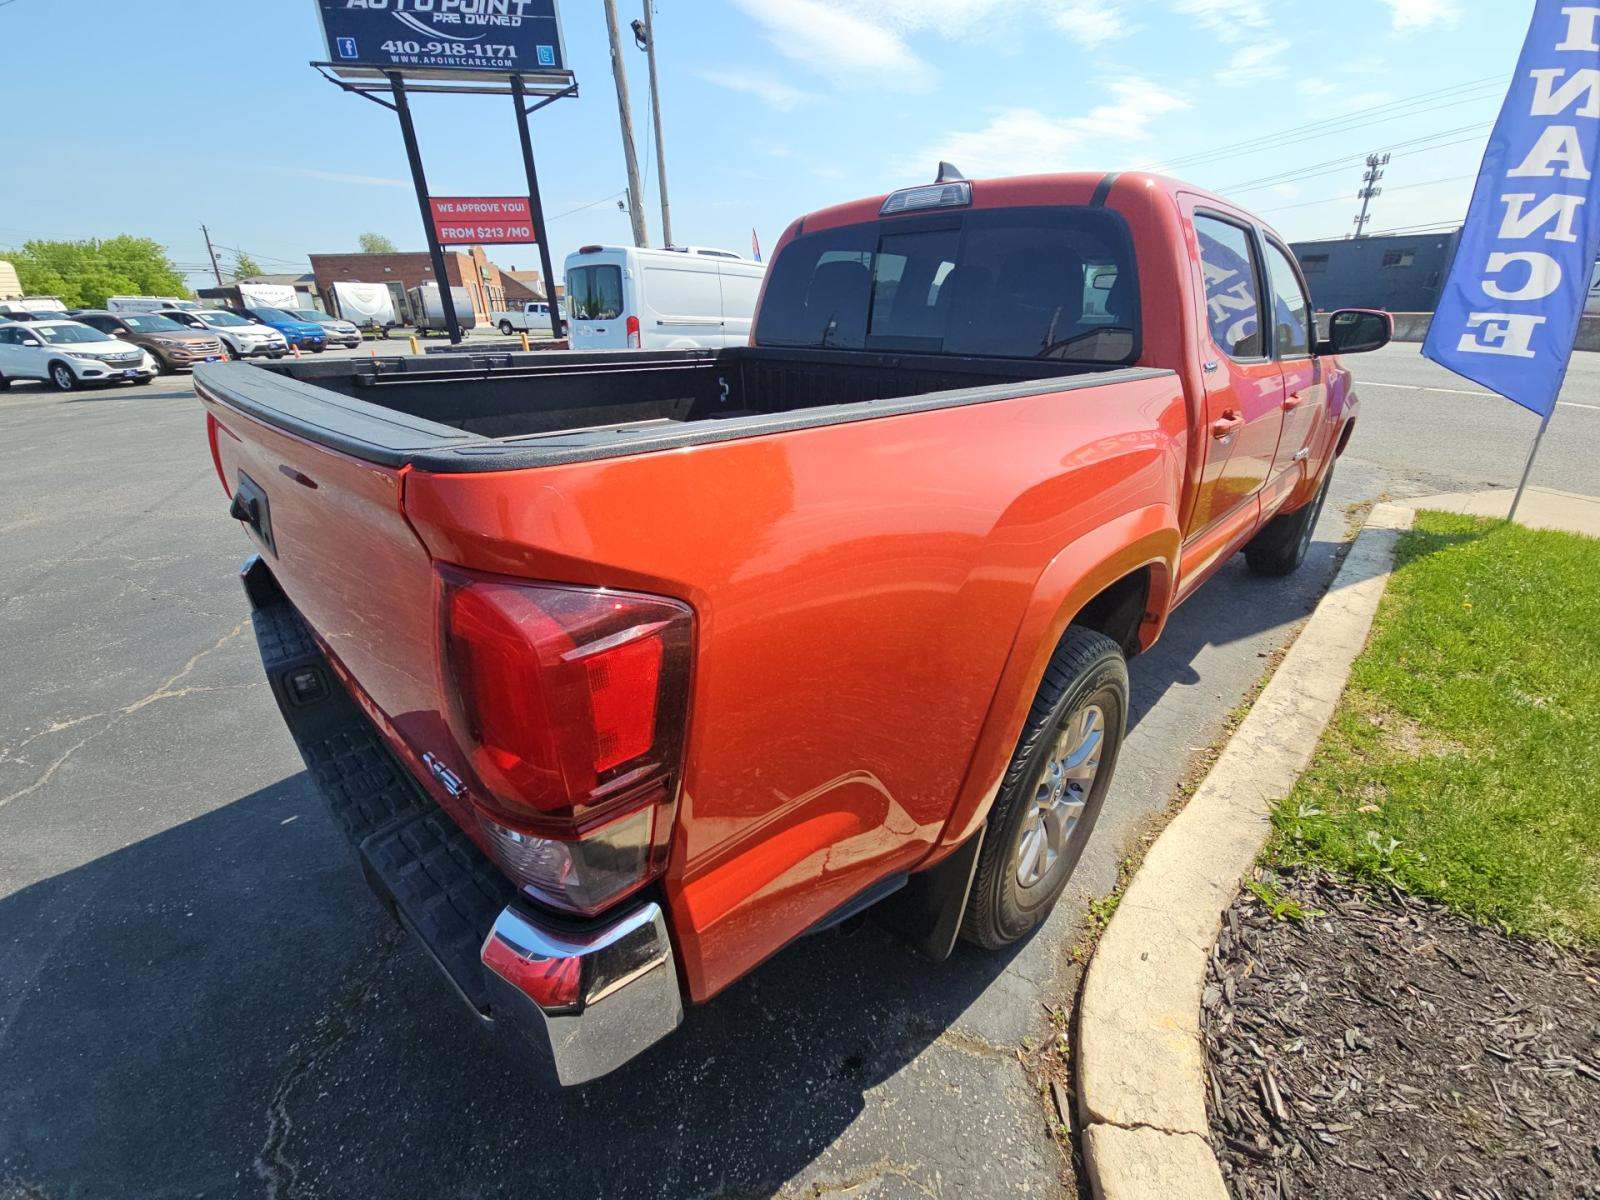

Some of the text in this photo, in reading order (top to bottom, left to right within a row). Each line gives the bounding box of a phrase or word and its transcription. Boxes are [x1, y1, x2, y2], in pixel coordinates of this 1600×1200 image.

[441, 0, 532, 16] POINT
[433, 12, 522, 27] PRE OWNED
[380, 40, 518, 58] 410-918-1171
[390, 55, 513, 67] WWW.APOINTCARS.COM
[437, 203, 525, 213] WE APPROVE YOU!
[441, 227, 530, 239] FROM $213 /MO
